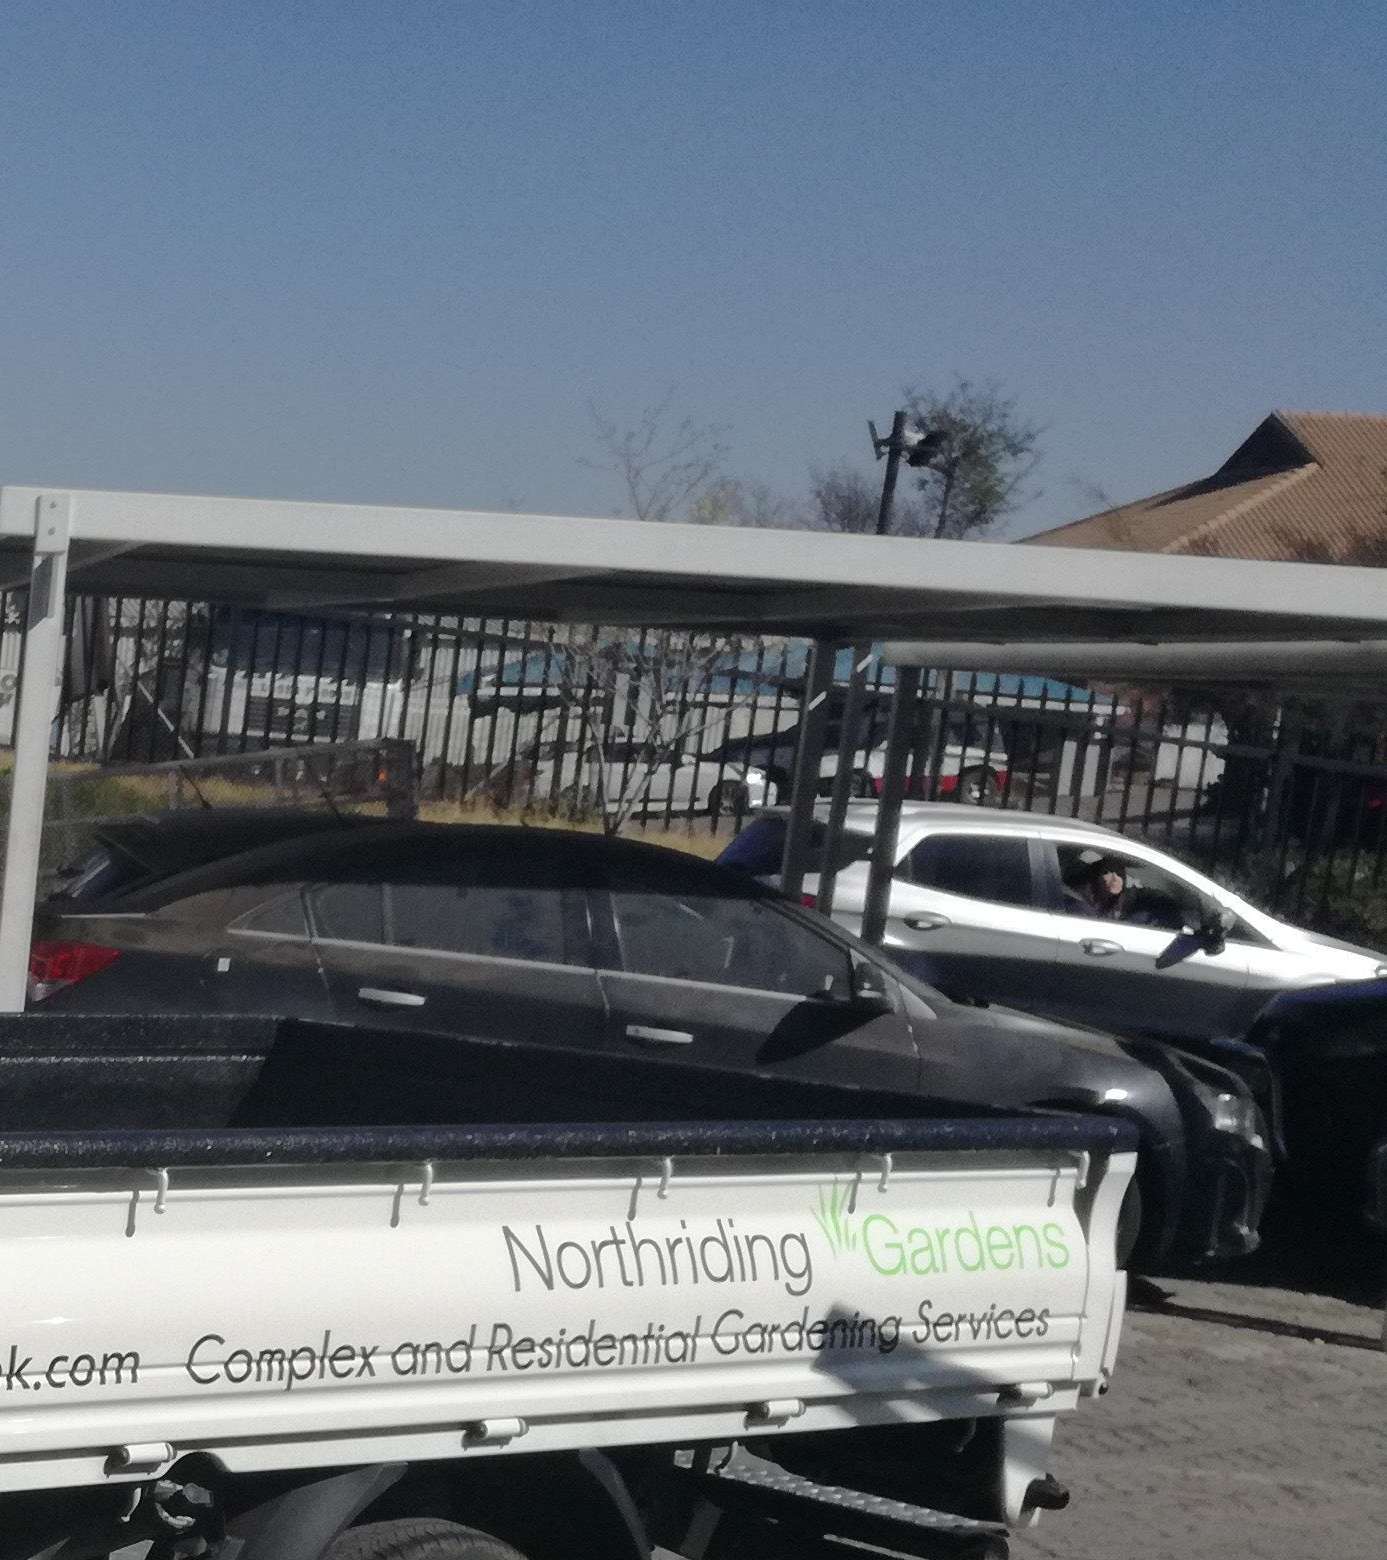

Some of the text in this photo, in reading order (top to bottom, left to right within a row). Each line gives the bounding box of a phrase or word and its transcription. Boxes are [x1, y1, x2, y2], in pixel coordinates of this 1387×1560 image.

[502, 1212, 1071, 1297] Northriding Gardens
[184, 1299, 1051, 1391] Complex and Residential Gardening Services
